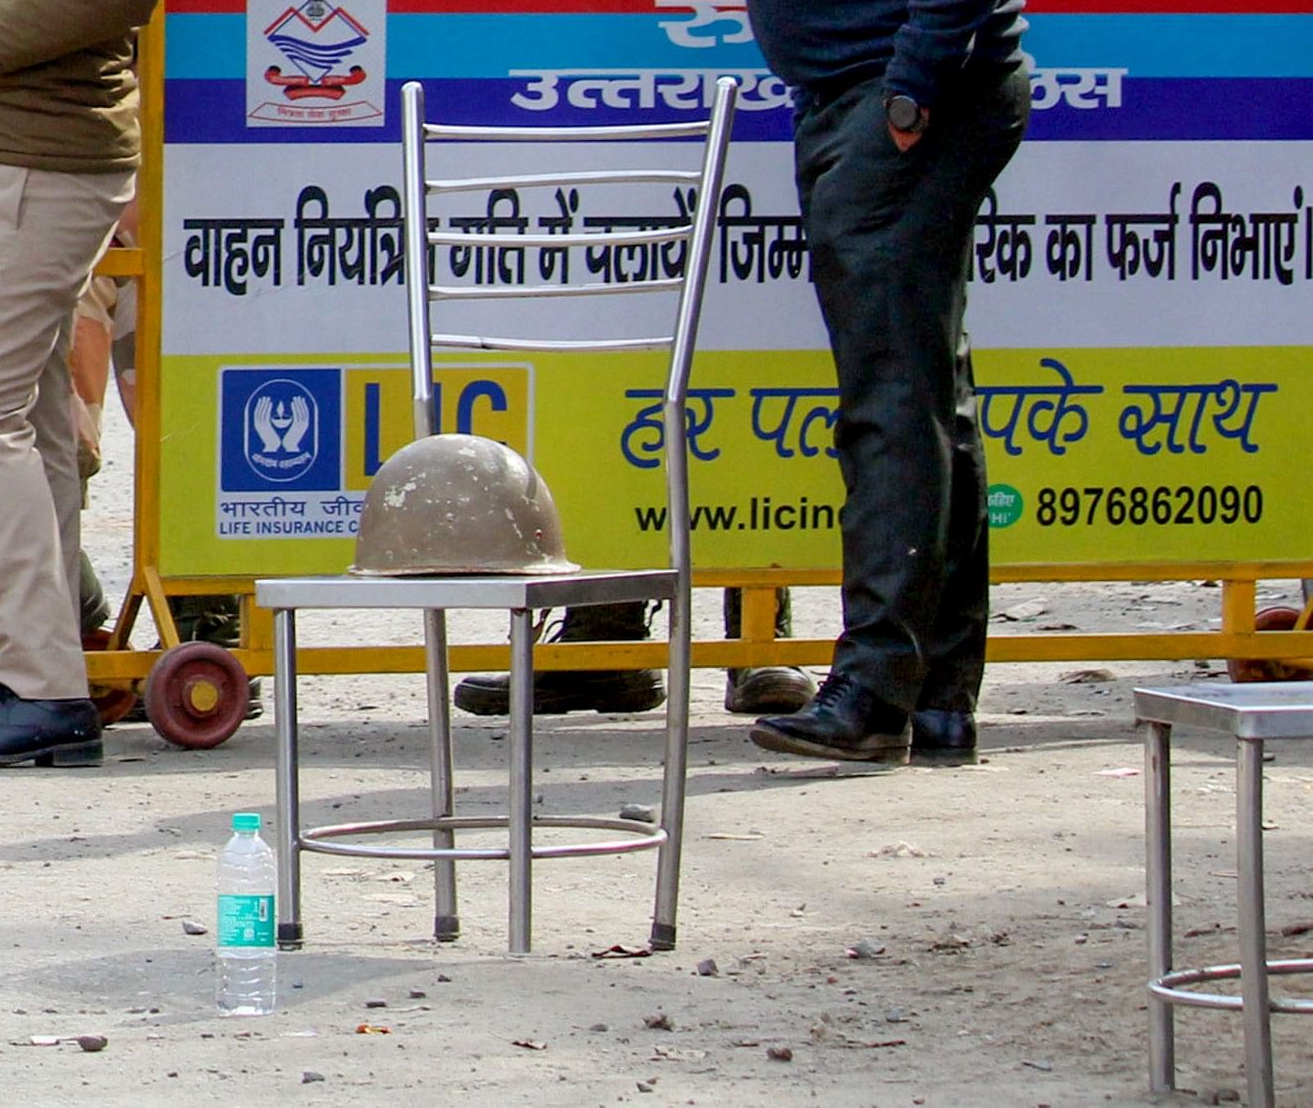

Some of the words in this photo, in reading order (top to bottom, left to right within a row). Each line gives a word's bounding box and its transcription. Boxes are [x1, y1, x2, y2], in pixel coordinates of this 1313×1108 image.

[508, 68, 796, 112] उत्तराख
[183, 218, 284, 296] वाहन
[449, 188, 528, 284] गति
[538, 187, 579, 284] में
[1045, 214, 1096, 282] का
[1105, 182, 1181, 281] फर्ज
[621, 388, 735, 468] हर
[973, 358, 1104, 456] पके
[1118, 379, 1278, 455] साथ
[220, 497, 306, 517] भारतीय
[220, 520, 251, 534] LIFE
[256, 519, 341, 534] INSURANCE
[1036, 485, 1263, 526] 8976862090
